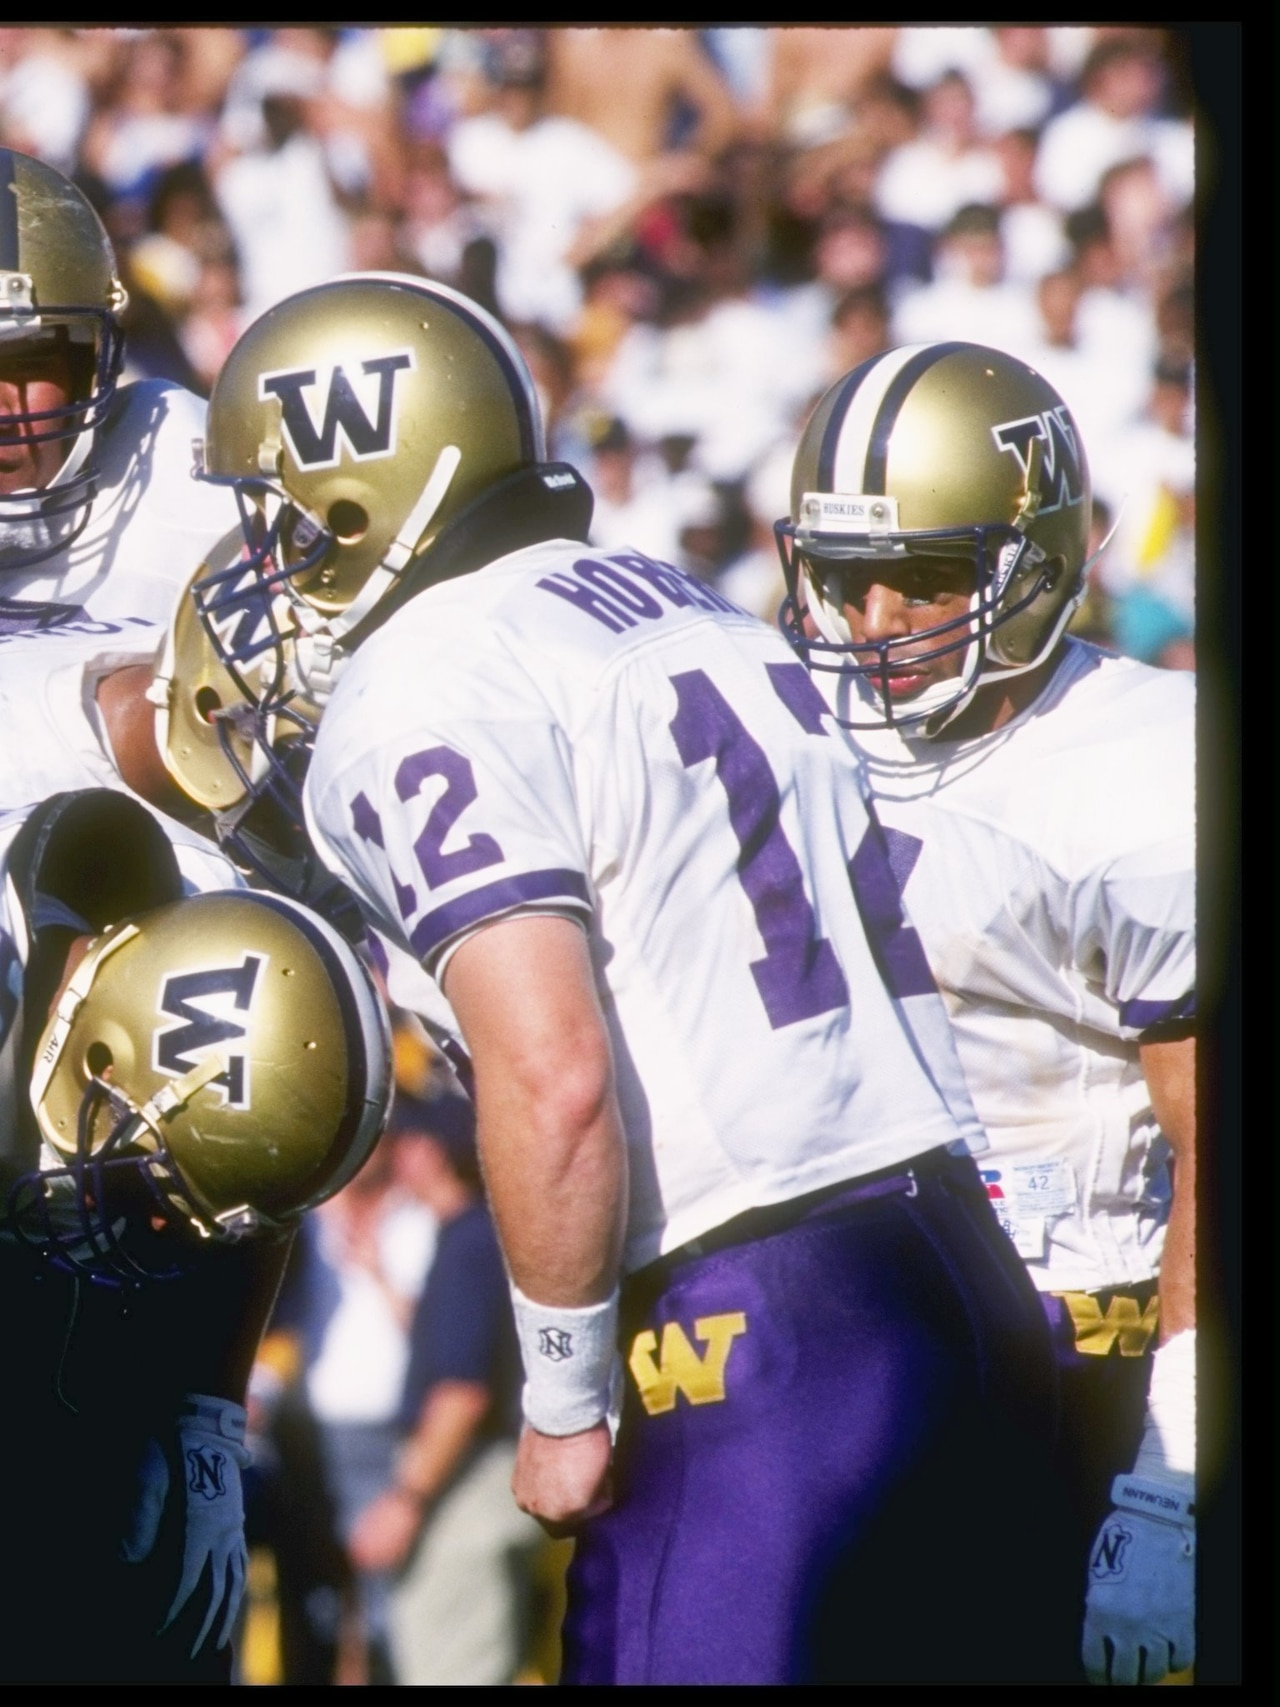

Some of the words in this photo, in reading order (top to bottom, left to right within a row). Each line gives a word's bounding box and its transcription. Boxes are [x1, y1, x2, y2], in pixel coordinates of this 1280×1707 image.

[258, 346, 417, 472] W
[991, 404, 1085, 516] W
[823, 502, 865, 516] HUSKIES
[349, 745, 506, 922] 12
[152, 949, 270, 1111] W
[1027, 1175, 1050, 1191] 42
[629, 1312, 747, 1416] W
[192, 1449, 224, 1495] N
[1122, 1486, 1179, 1511] NEUMANN
[1092, 1529, 1129, 1574] N
